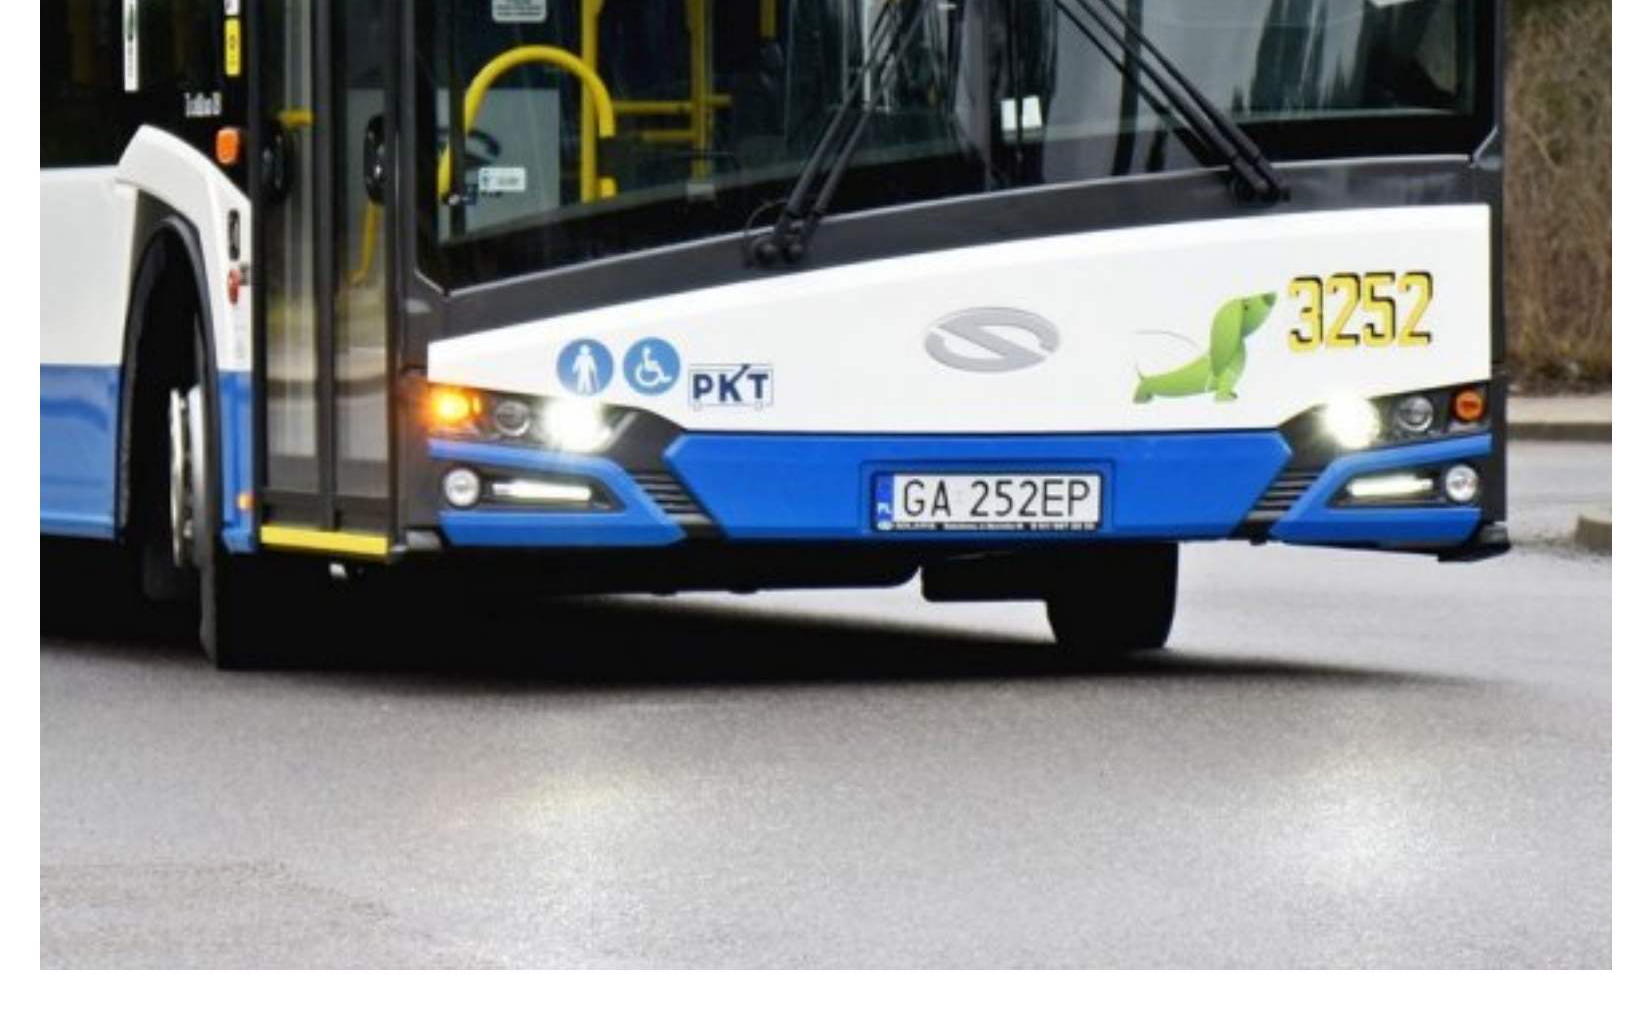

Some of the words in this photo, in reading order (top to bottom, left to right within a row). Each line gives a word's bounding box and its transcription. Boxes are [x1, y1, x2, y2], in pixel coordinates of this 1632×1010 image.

[1288, 271, 1434, 354] 3252
[692, 363, 769, 403] PKT
[903, 478, 951, 518] GA
[969, 478, 1091, 518] 252EP
